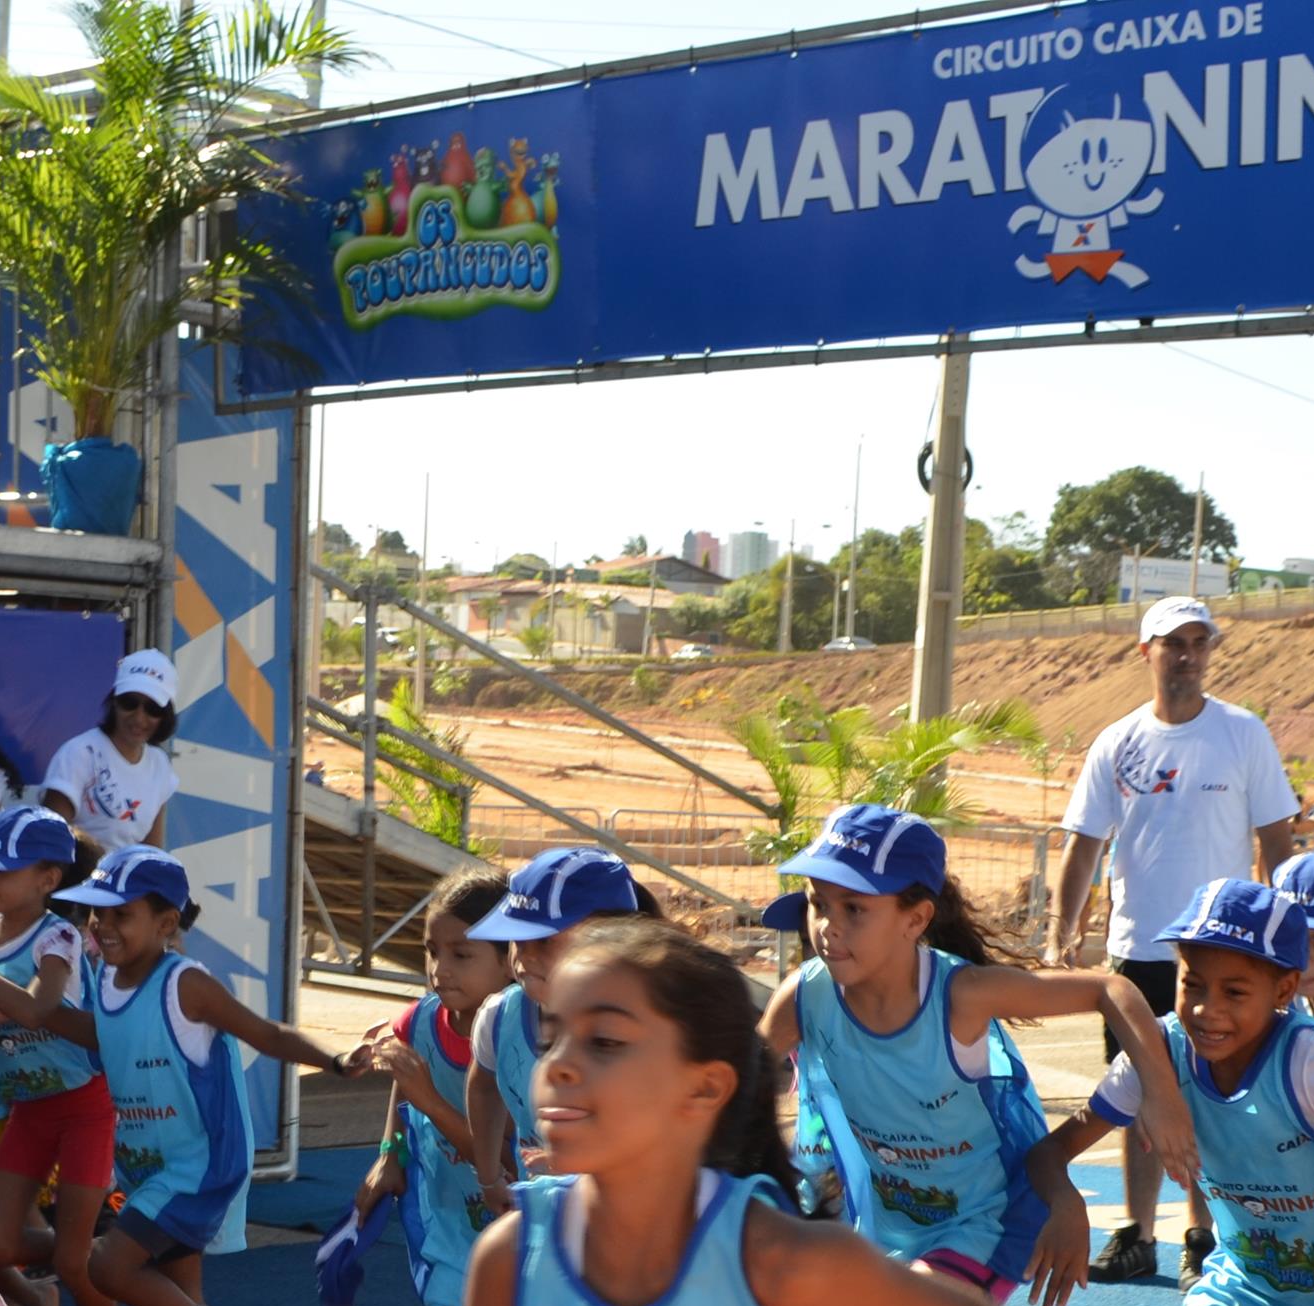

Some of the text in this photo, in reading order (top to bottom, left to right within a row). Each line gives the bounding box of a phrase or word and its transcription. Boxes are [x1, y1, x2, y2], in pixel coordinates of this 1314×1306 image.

[933, 2, 1264, 80] CIRCUITO CAIXA DE
[416, 198, 457, 249] OS
[129, 665, 165, 682] CAIXA
[1200, 783, 1230, 793] CAIXA
[1206, 918, 1255, 944] CAIXA
[135, 1057, 172, 1071] CAIXA
[918, 1089, 959, 1112] CAIXA
[882, 1132, 918, 1143] CAIXA
[1276, 1132, 1312, 1154] CAIX
[1247, 1183, 1285, 1193] CAIXA
[1286, 1184, 1299, 1193] DE
